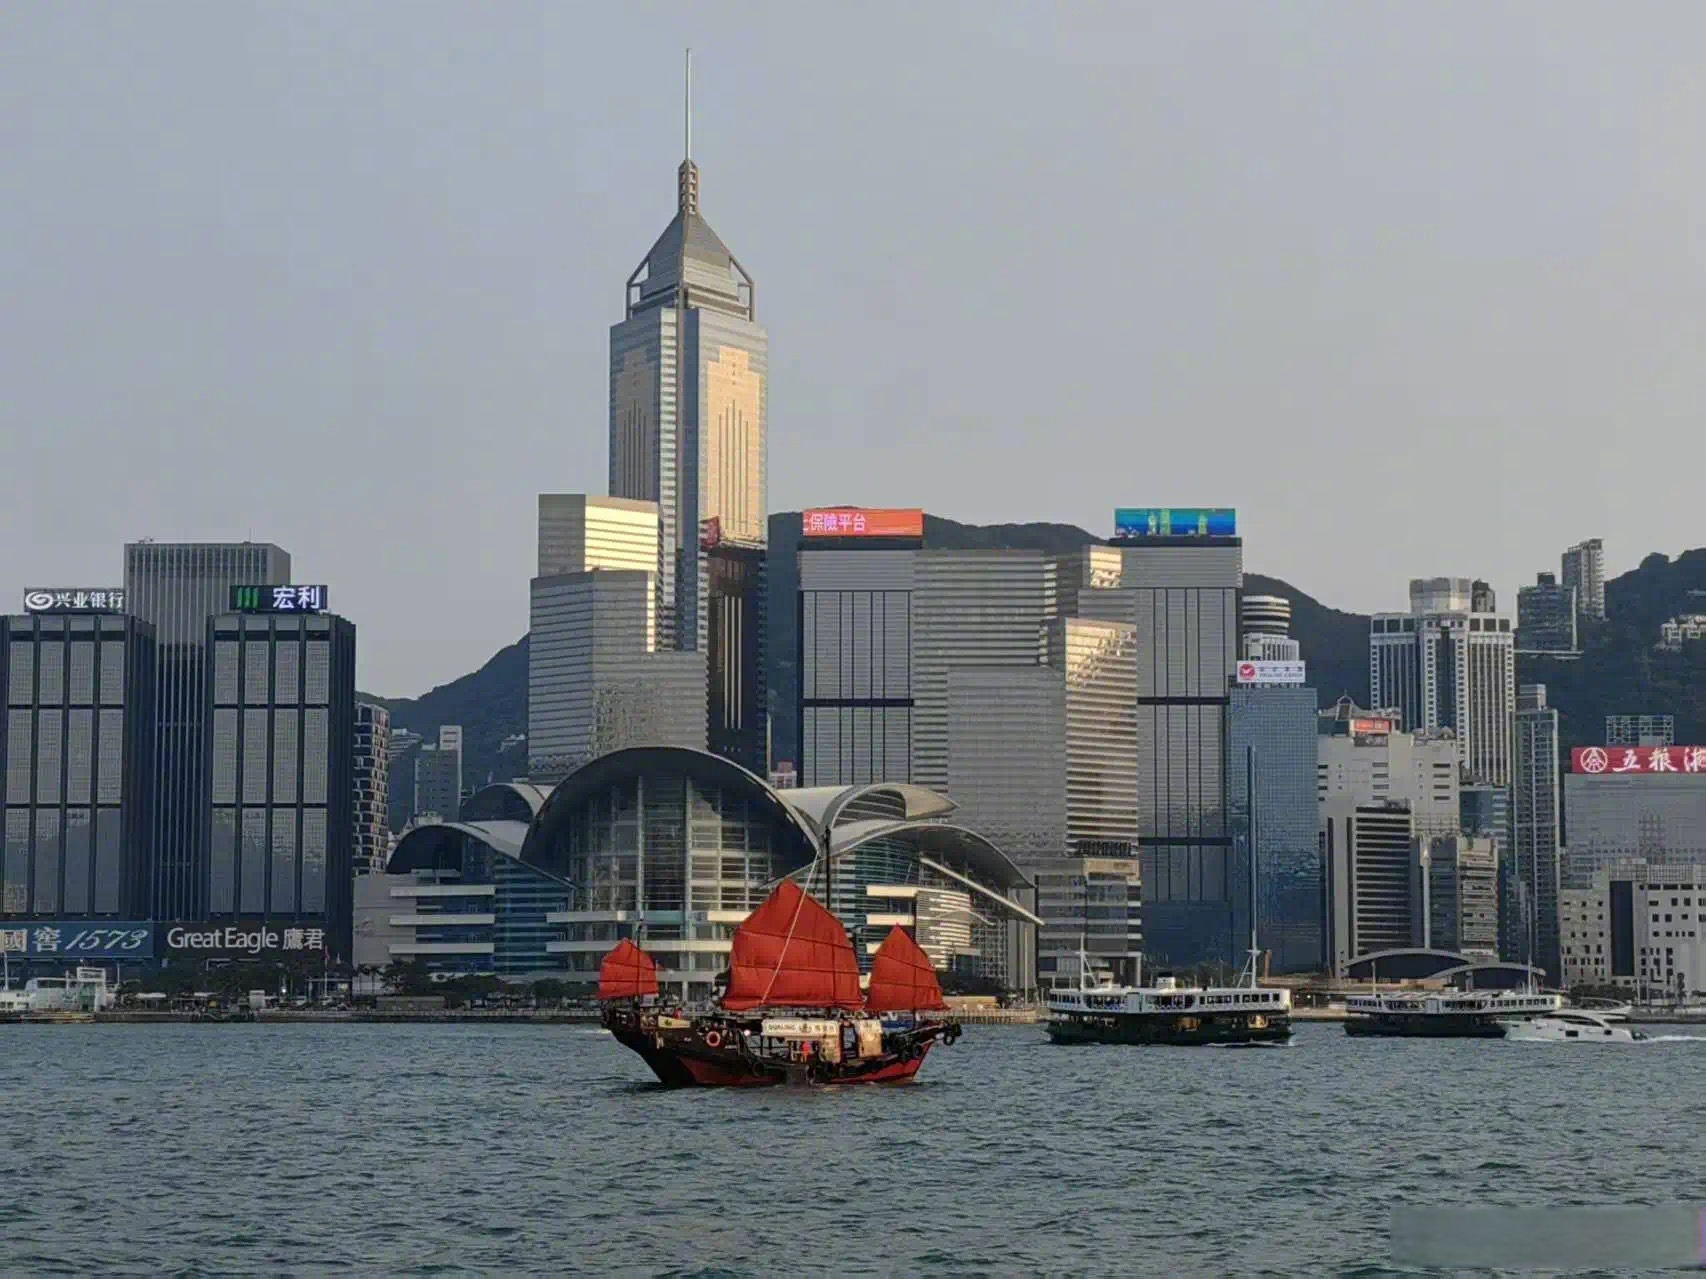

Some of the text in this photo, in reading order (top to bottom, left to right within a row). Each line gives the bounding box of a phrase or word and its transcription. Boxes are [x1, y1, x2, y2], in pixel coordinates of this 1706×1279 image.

[54, 591, 124, 609] 兴业银行
[272, 584, 320, 609] 宏利
[64, 928, 149, 951] 1573
[167, 926, 326, 954] Great Eagle 鷹君
